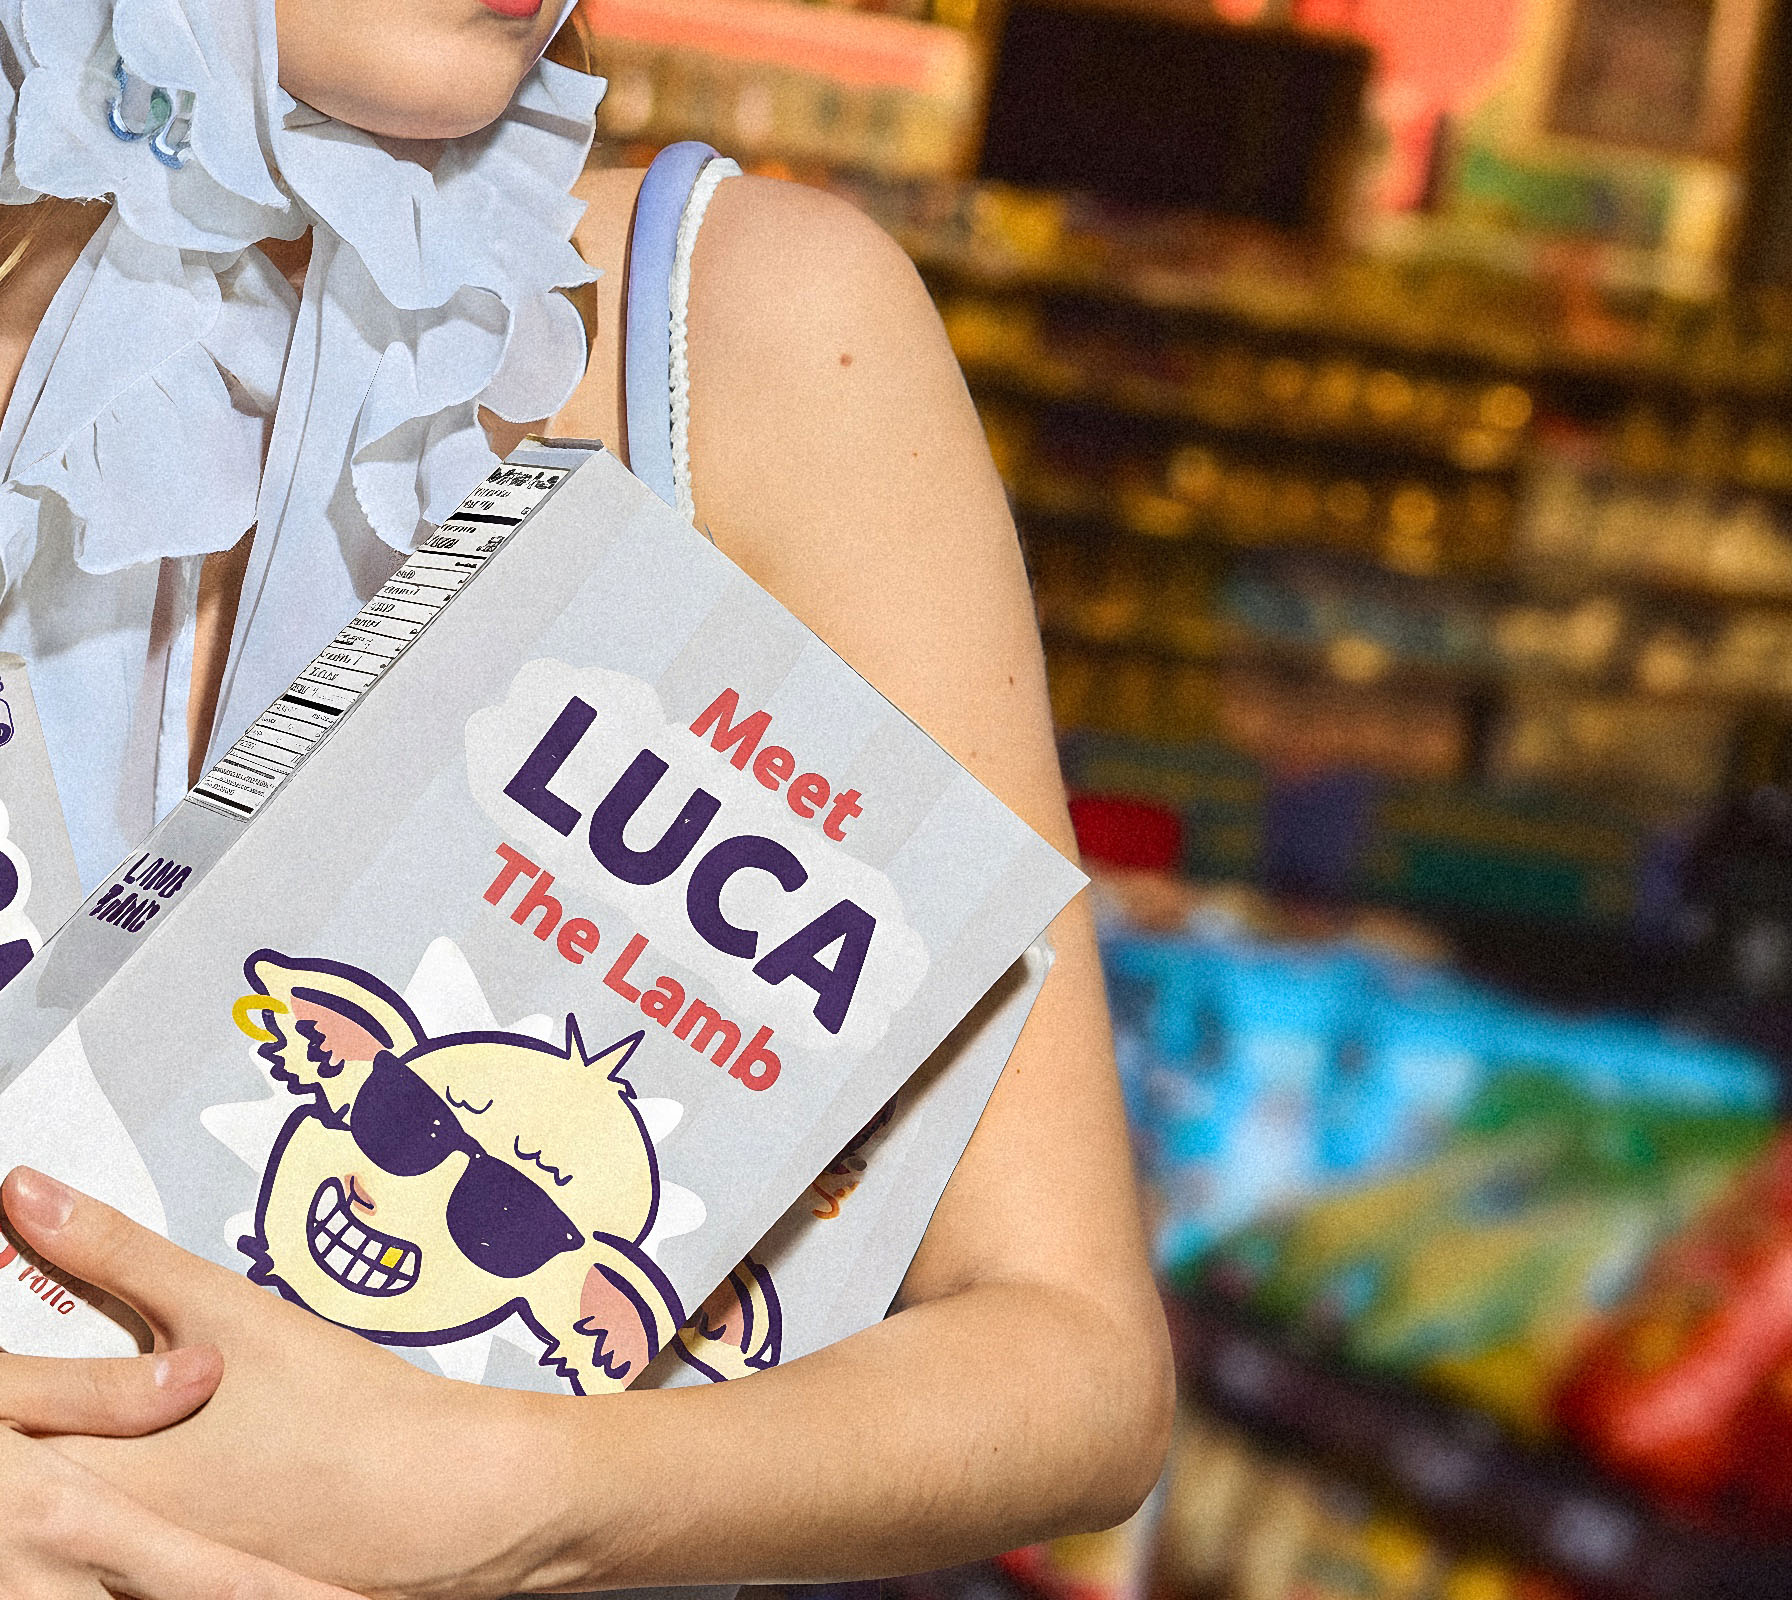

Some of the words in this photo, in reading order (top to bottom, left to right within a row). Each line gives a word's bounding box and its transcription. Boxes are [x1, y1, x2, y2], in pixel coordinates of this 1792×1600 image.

[503, 696, 877, 1035] LUCA
[688, 687, 863, 842] Meet
[482, 842, 602, 964] The
[603, 932, 782, 1092] Lamb
